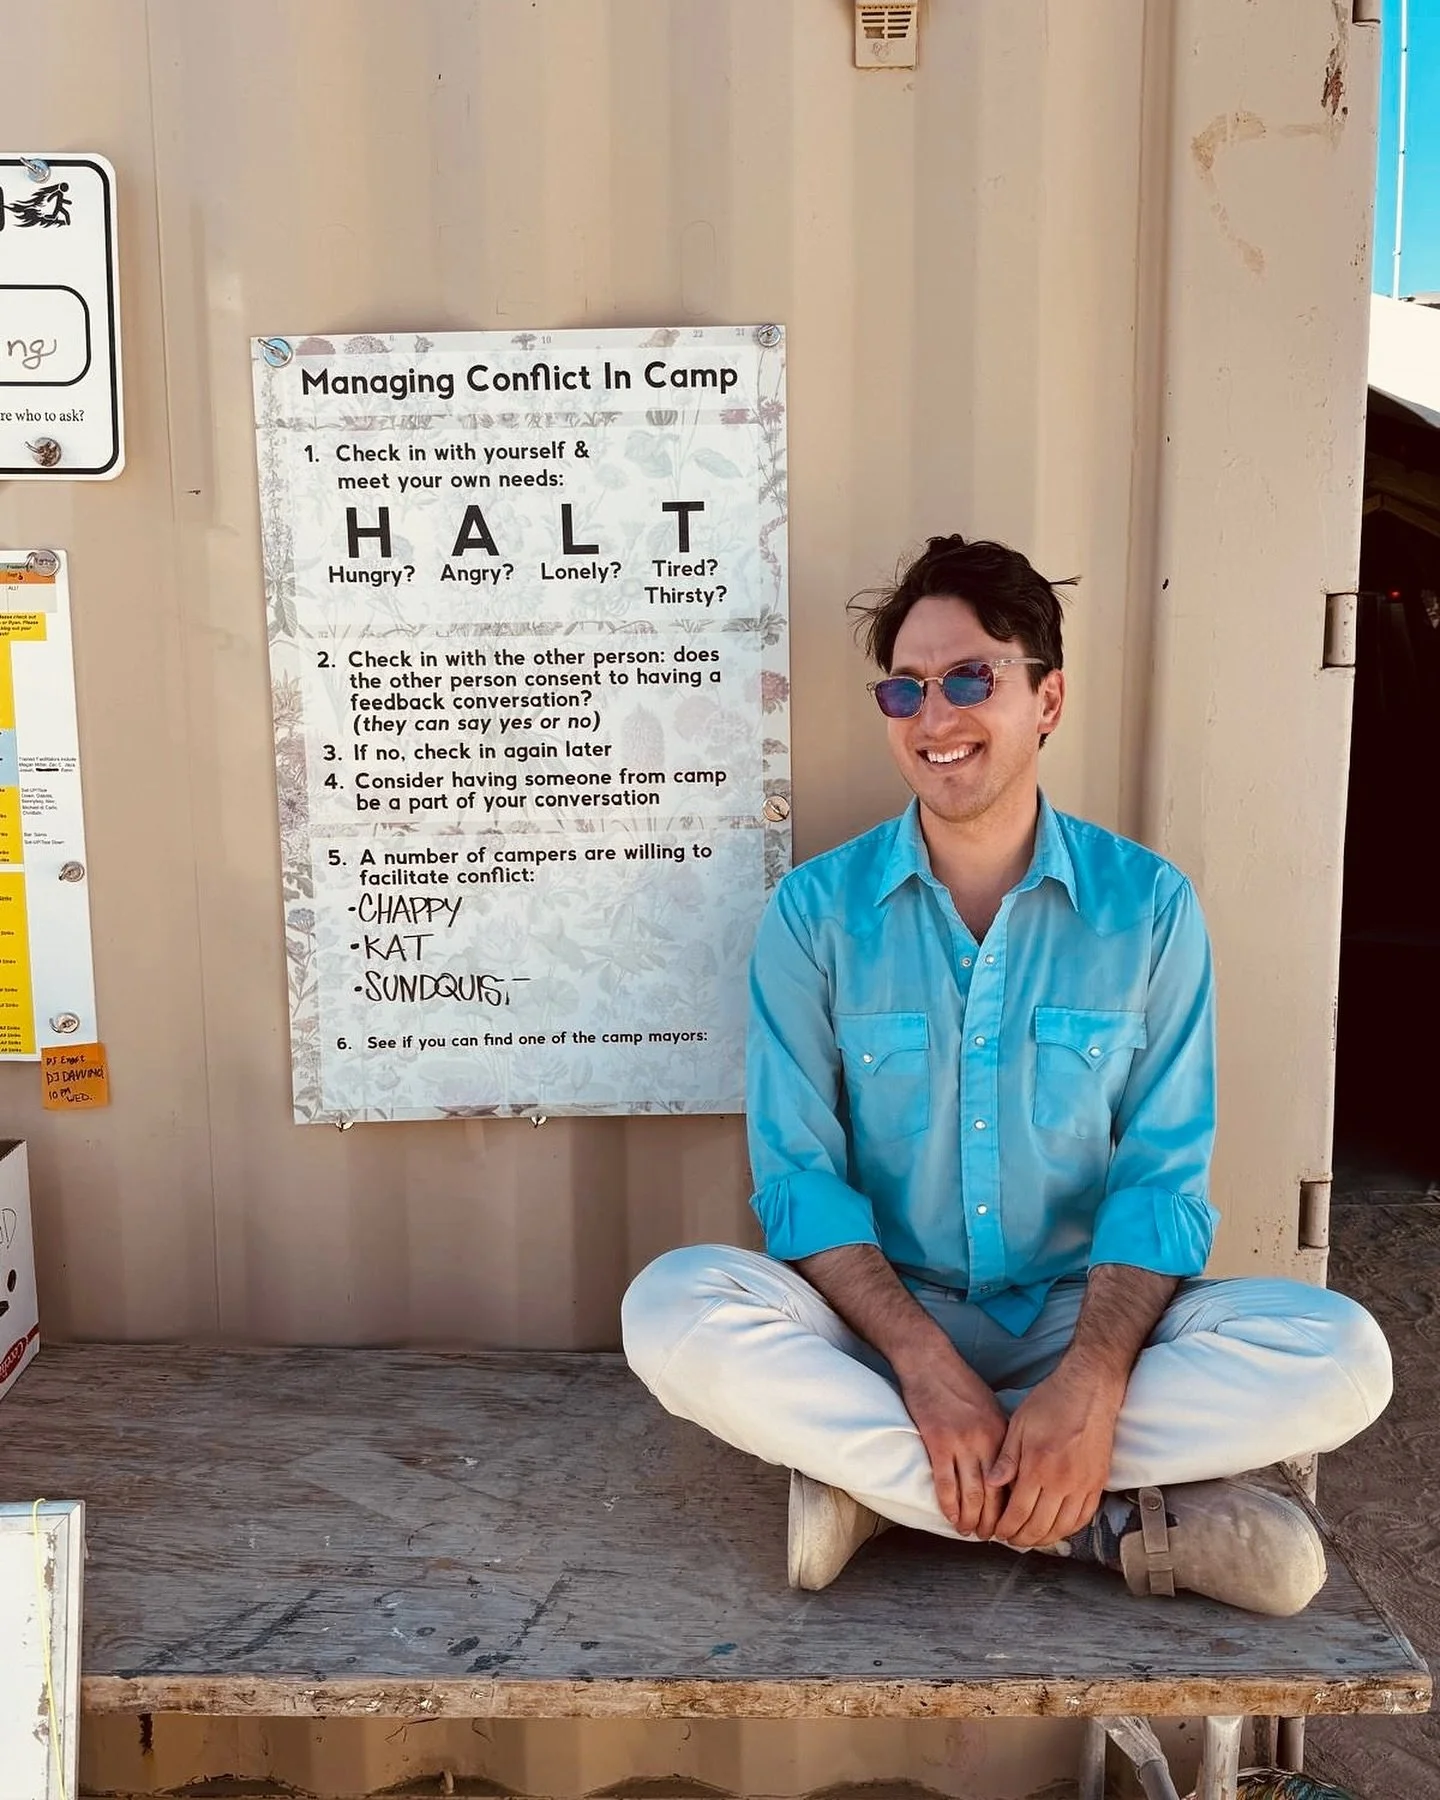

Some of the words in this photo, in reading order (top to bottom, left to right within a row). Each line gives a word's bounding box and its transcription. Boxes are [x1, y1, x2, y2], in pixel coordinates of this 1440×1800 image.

[301, 367, 455, 401] Managing
[466, 362, 592, 392] Conflict
[604, 361, 631, 390] In
[644, 361, 738, 395] Camp
[16, 409, 41, 421] who
[45, 412, 56, 421] to
[60, 409, 84, 421] ask?
[304, 444, 320, 463] 1.
[336, 443, 401, 462] Check
[409, 443, 426, 461] in
[434, 442, 476, 461] with
[483, 440, 566, 465] yourself
[574, 440, 590, 459] &
[338, 473, 390, 490] meet
[397, 475, 443, 494] your
[450, 475, 491, 488] own
[499, 468, 564, 488] needs:
[346, 506, 392, 559] H
[451, 504, 500, 557] A
[561, 503, 600, 555] L
[661, 501, 705, 553] T
[328, 564, 415, 588] Hungry?
[440, 563, 514, 586] Angry?
[541, 561, 622, 584] Lonely?
[651, 558, 719, 577] Tired?
[644, 585, 727, 608] Thirsty?
[317, 651, 336, 668] 2.
[348, 650, 413, 668] Check
[420, 649, 438, 667] in
[445, 649, 487, 667] with
[493, 648, 525, 666] the
[533, 647, 586, 666] other
[593, 649, 665, 669] person:
[673, 645, 720, 663] does
[349, 671, 382, 689] the
[389, 671, 442, 689] other
[450, 675, 517, 692] person
[524, 670, 602, 687] consent
[608, 670, 629, 685] to
[636, 667, 702, 688] having
[709, 670, 721, 683] a
[350, 692, 445, 711] feedback
[452, 689, 592, 710] conversation?
[353, 714, 407, 736] (they
[414, 719, 450, 732] can
[457, 718, 492, 735] say
[499, 717, 532, 735] yes
[540, 717, 561, 729] or
[568, 710, 601, 733] no)
[323, 744, 343, 761] 3.
[354, 743, 369, 761] If
[376, 748, 406, 763] no,
[414, 742, 471, 760] check
[479, 741, 496, 759] in
[503, 741, 558, 763] again
[565, 740, 612, 757] later
[324, 773, 344, 790] 4.
[355, 771, 444, 789] Consider
[452, 771, 517, 791] having
[525, 773, 612, 787] someone
[618, 767, 666, 785] from
[673, 770, 727, 787] camp
[356, 793, 381, 811] be
[388, 797, 401, 810] a
[408, 793, 449, 815] part
[456, 791, 477, 809] of
[483, 795, 527, 813] your
[534, 789, 660, 808] conversation
[328, 849, 347, 866] 5.
[359, 848, 376, 866] A
[384, 847, 459, 865] number
[466, 846, 487, 863] of
[494, 849, 577, 866] campers
[584, 849, 617, 861] are
[624, 842, 685, 863] willing
[692, 843, 713, 859] to
[359, 868, 449, 886] facilitate
[457, 866, 535, 884] conflict:
[336, 1037, 352, 1050] 6.
[367, 1036, 397, 1049] See
[402, 1035, 413, 1049] if
[418, 1037, 446, 1051] you
[451, 1037, 479, 1048] can
[483, 1032, 513, 1047] find
[518, 1035, 546, 1046] one
[551, 1031, 568, 1044] of
[572, 1030, 596, 1044] the
[601, 1033, 643, 1047] camp
[648, 1031, 708, 1045] mayors:
